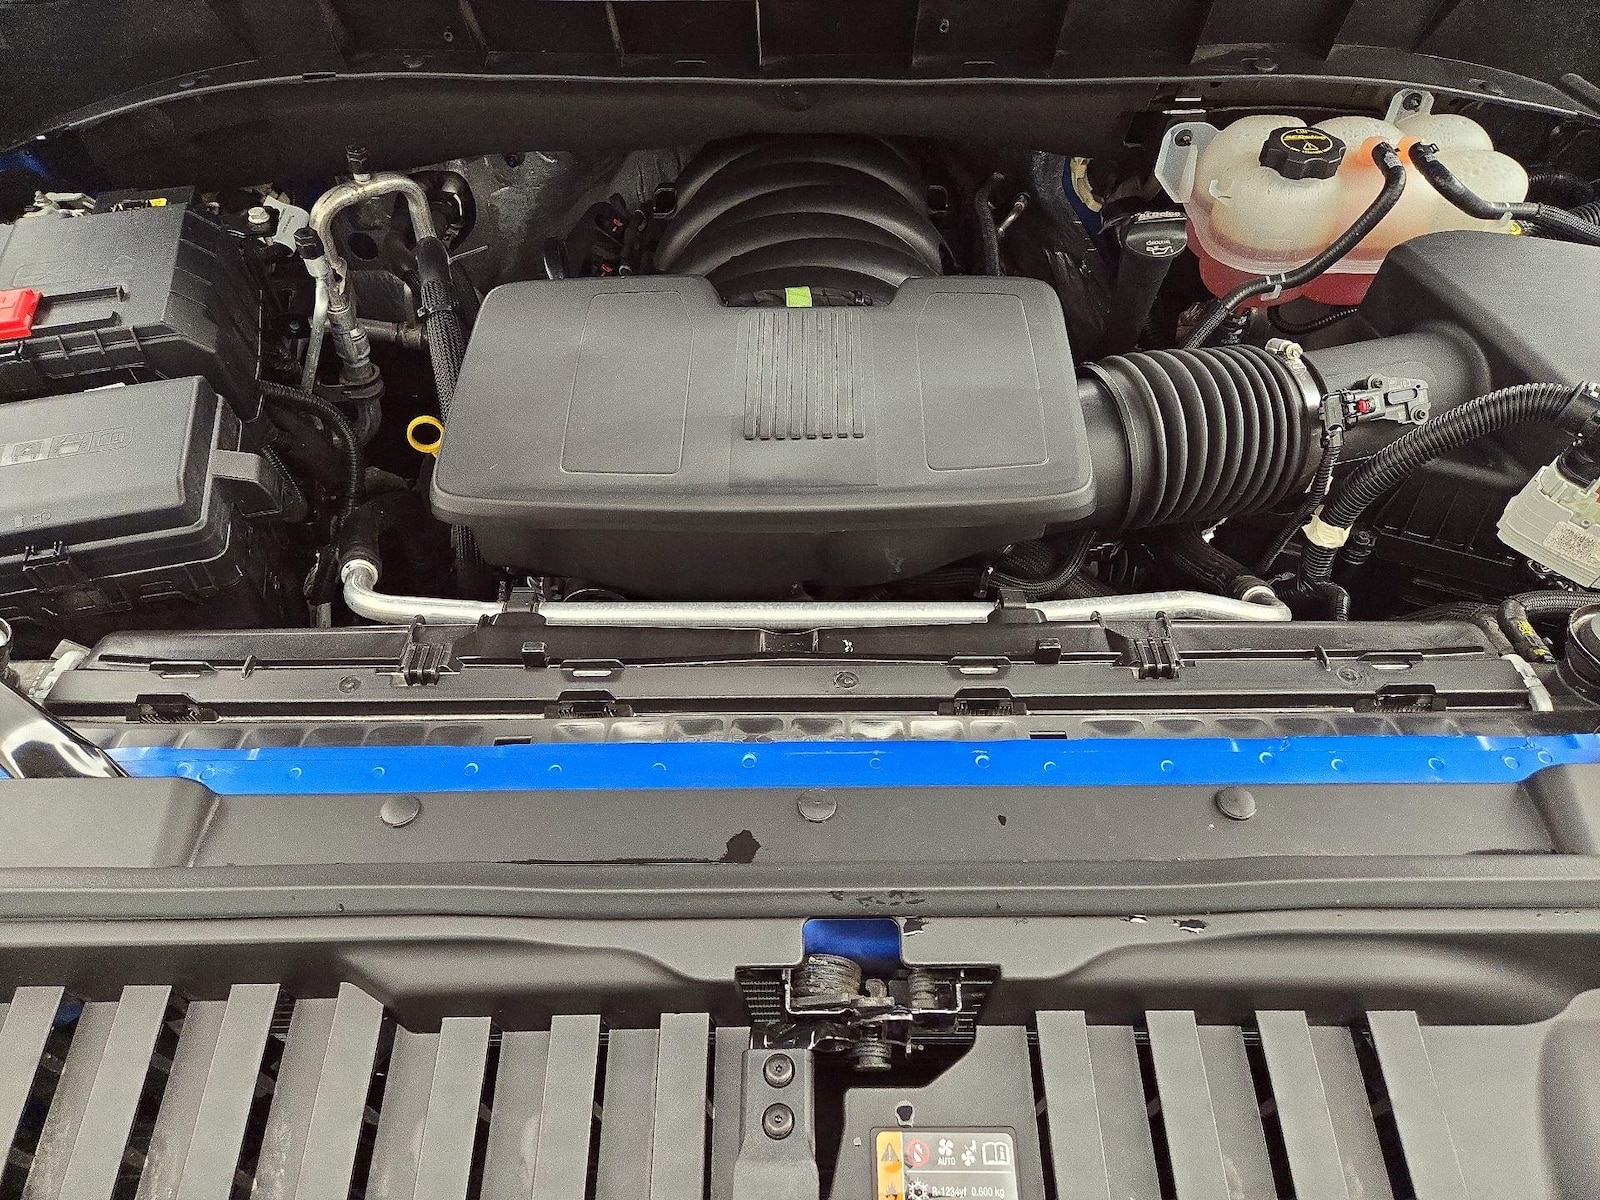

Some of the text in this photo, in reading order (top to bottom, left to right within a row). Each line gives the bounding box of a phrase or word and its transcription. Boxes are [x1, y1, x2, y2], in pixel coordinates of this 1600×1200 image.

[937, 1156, 956, 1166] AUTO
[931, 1185, 1005, 1199] R-1234yf 0.600 kg
